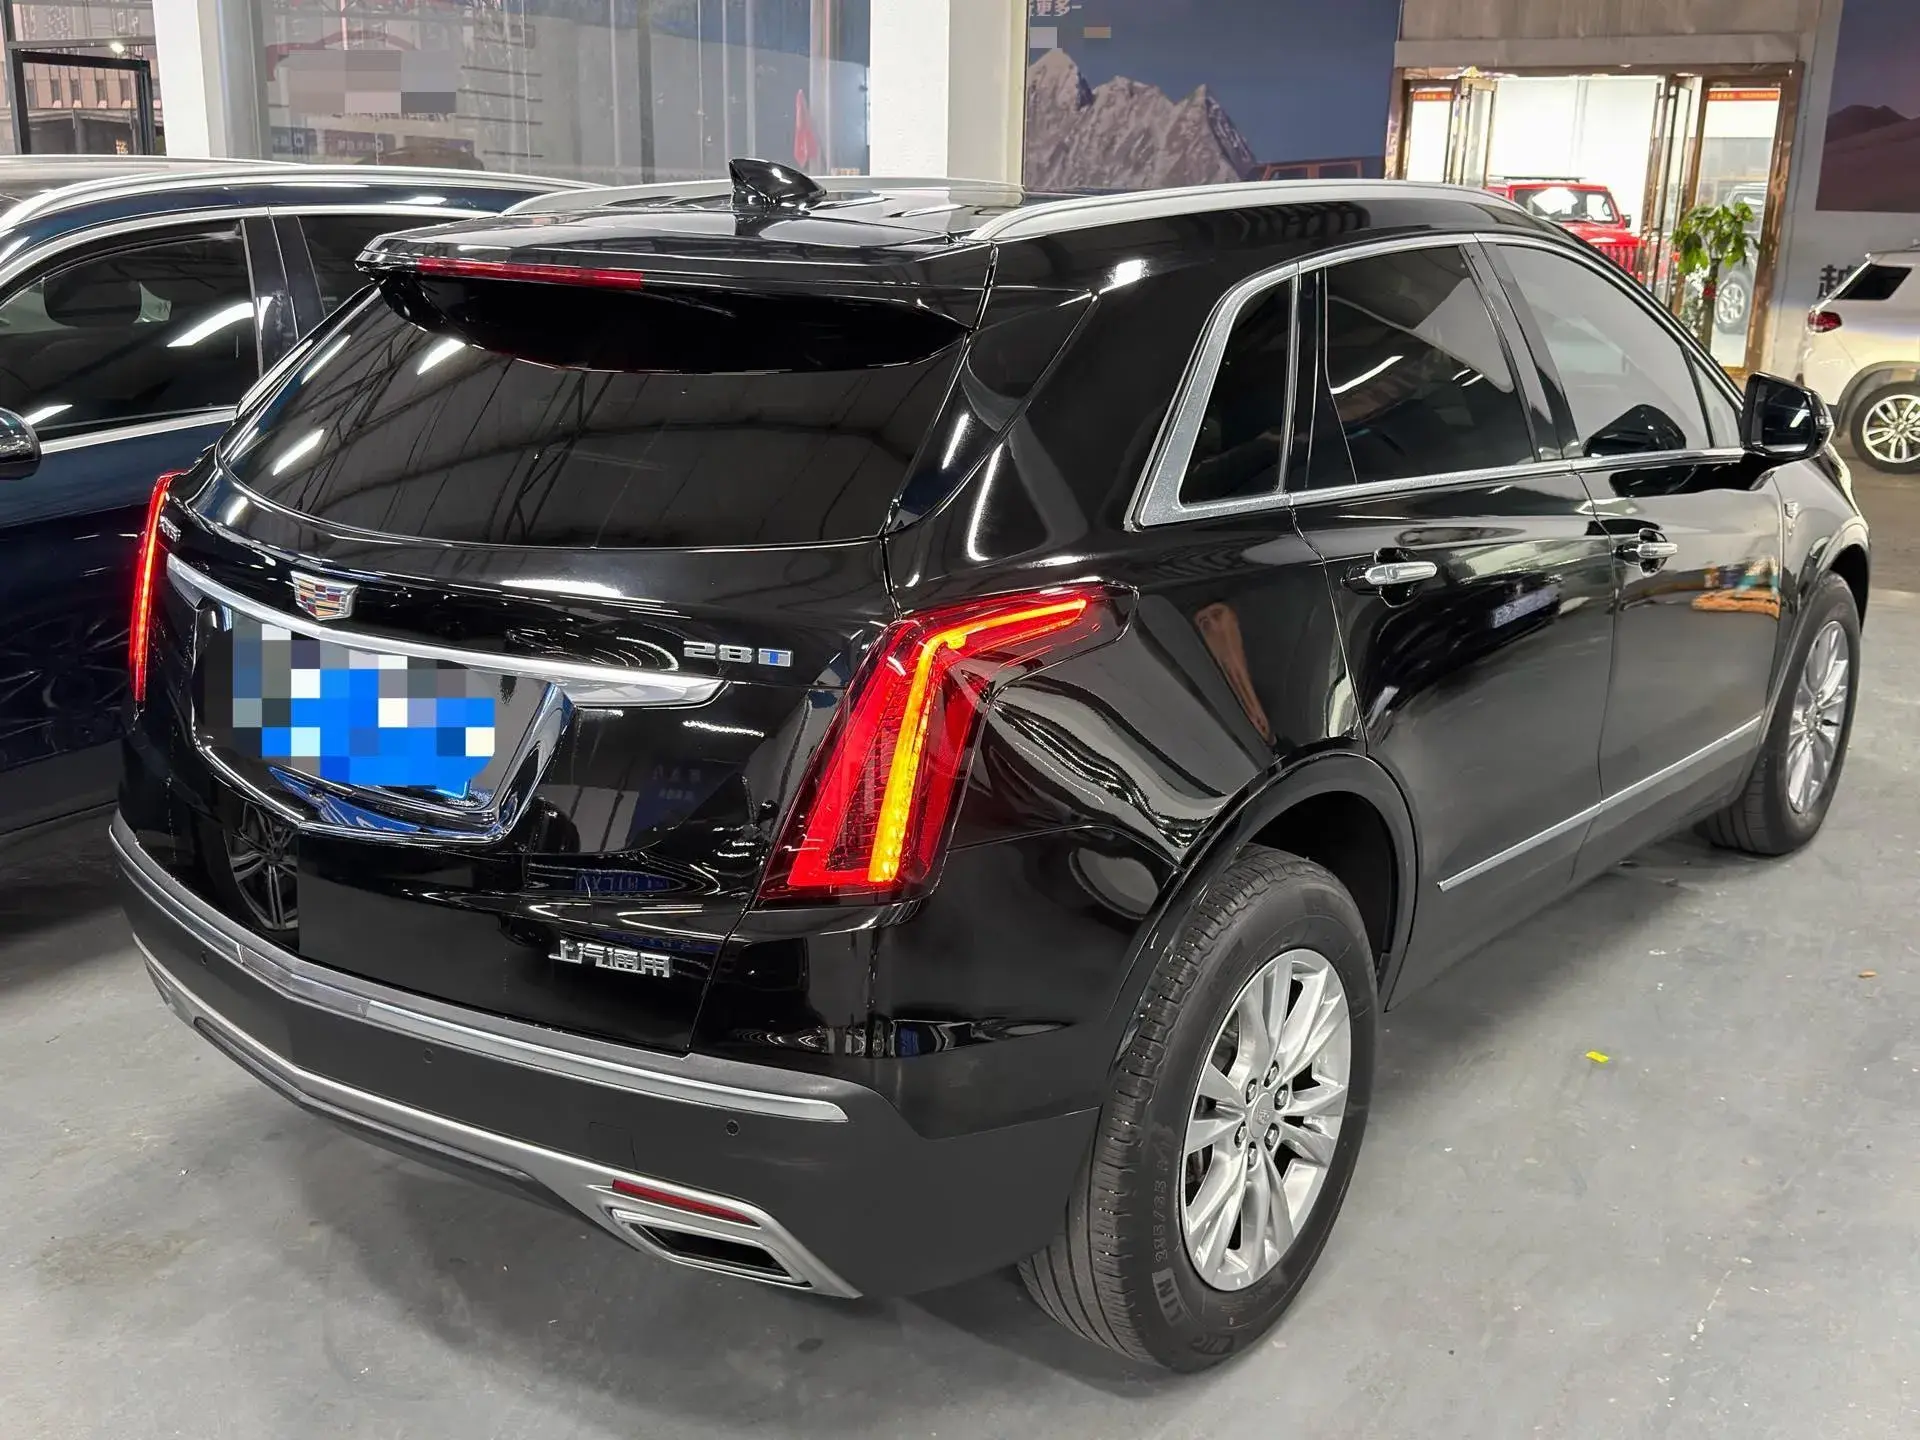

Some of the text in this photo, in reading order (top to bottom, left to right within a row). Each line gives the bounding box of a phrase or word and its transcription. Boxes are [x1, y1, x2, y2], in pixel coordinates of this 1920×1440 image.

[683, 640, 793, 667] 28T
[547, 939, 671, 978] 上汽通用
